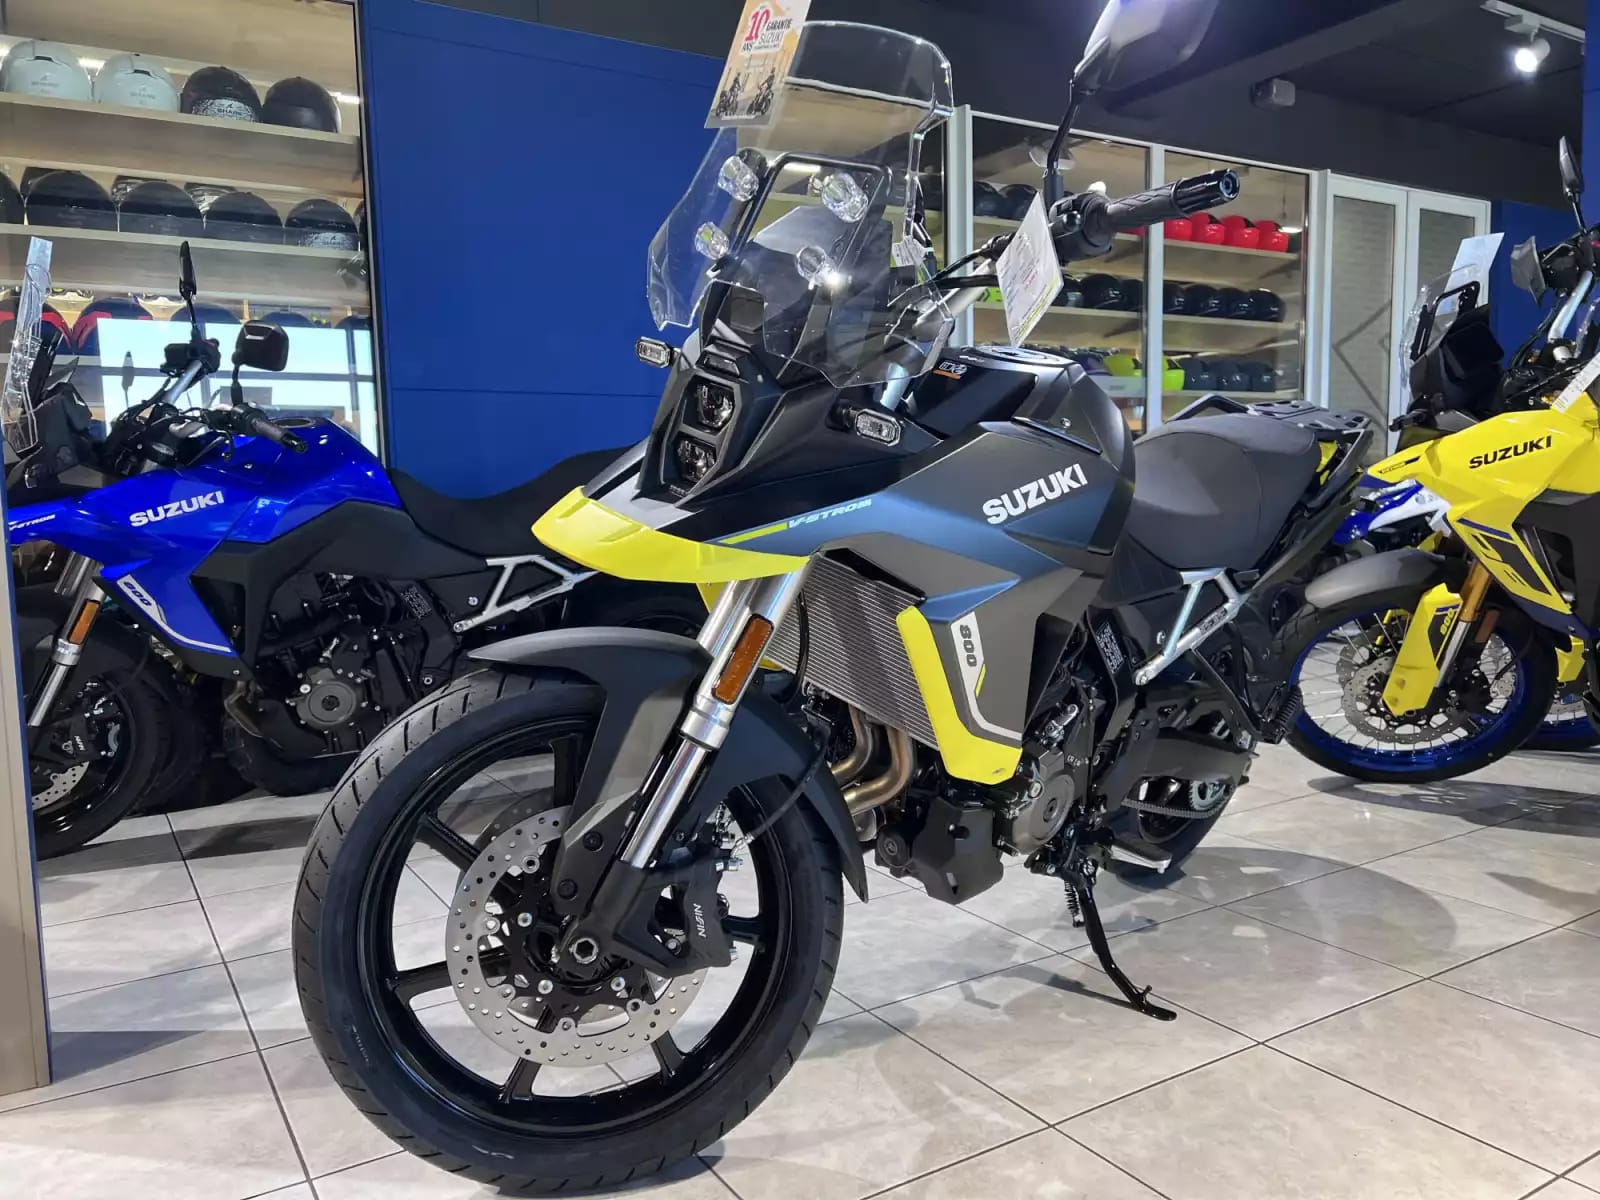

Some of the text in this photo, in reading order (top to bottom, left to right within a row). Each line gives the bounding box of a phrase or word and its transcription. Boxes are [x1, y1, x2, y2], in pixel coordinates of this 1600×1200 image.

[745, 9, 770, 41] 10
[759, 30, 784, 45] SUZUKI
[766, 17, 792, 31] GARANTIE
[1468, 436, 1552, 469] SUZUKI
[129, 490, 225, 527] SUZUKI
[982, 463, 1088, 525] SUZUKI
[788, 498, 872, 528] V-STROM
[122, 581, 152, 607] 800
[1440, 607, 1454, 635] 800
[959, 624, 977, 667] 800
[693, 903, 706, 938] NISSIN
